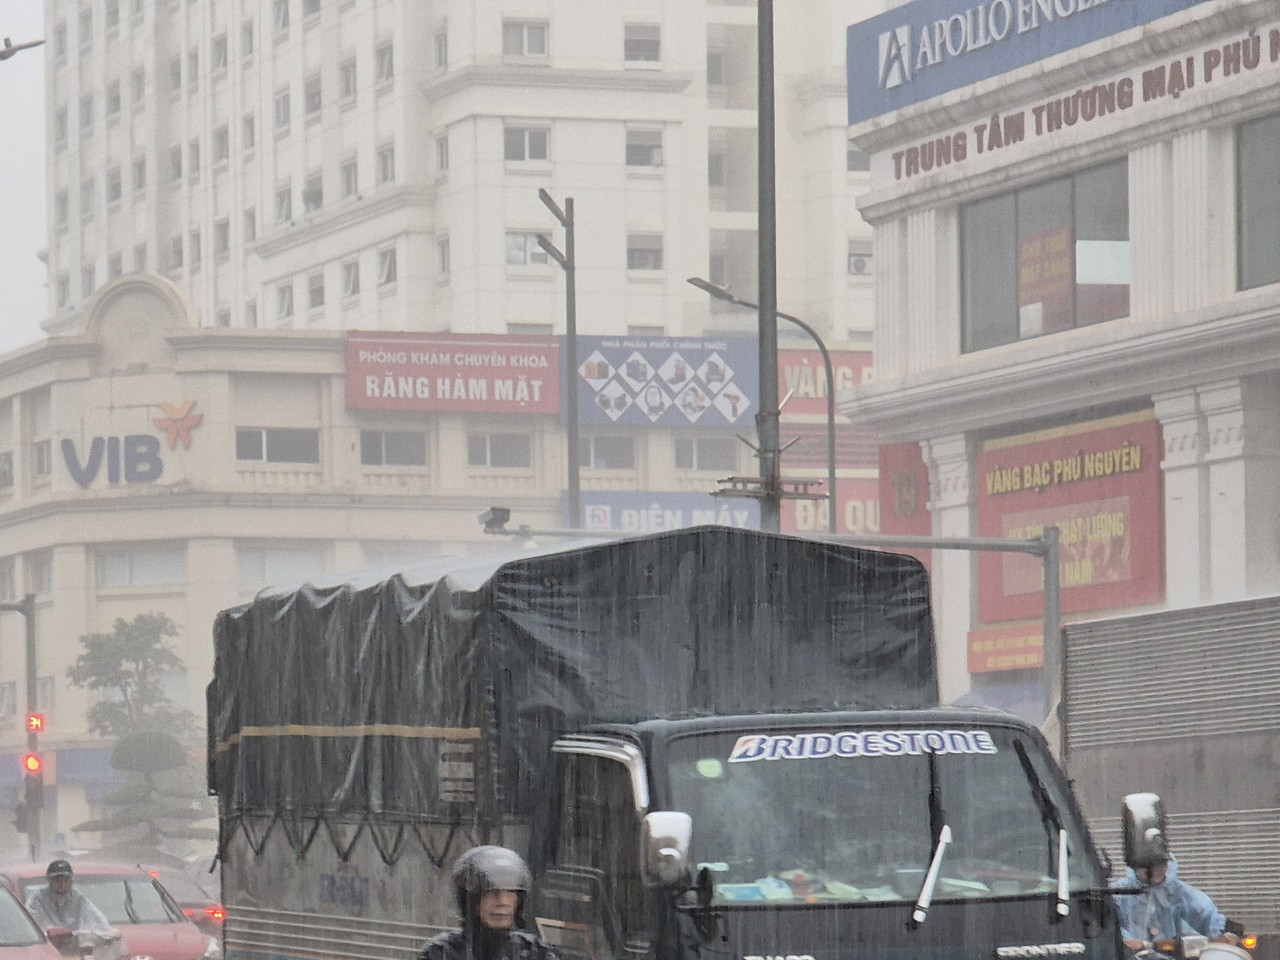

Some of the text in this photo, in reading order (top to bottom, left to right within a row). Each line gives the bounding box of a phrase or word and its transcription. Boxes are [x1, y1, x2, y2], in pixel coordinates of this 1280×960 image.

[915, 0, 1012, 70] APOLLO
[892, 131, 967, 180] TRUNG
[974, 112, 1025, 154] TÂM
[1142, 56, 1195, 102] MẠI
[1204, 28, 1261, 83] PHÚ
[359, 347, 407, 365] PHÒNG
[411, 348, 451, 366] KHÁM
[509, 353, 548, 368] KHOA
[366, 371, 543, 407] RĂNG HÀM MẶT
[61, 435, 163, 489] VIB
[986, 441, 1141, 495] VÀNG BẠC PHÚ NGUYÊN
[29, 716, 41, 729] 34
[732, 731, 997, 760] BRIDGESTONE
